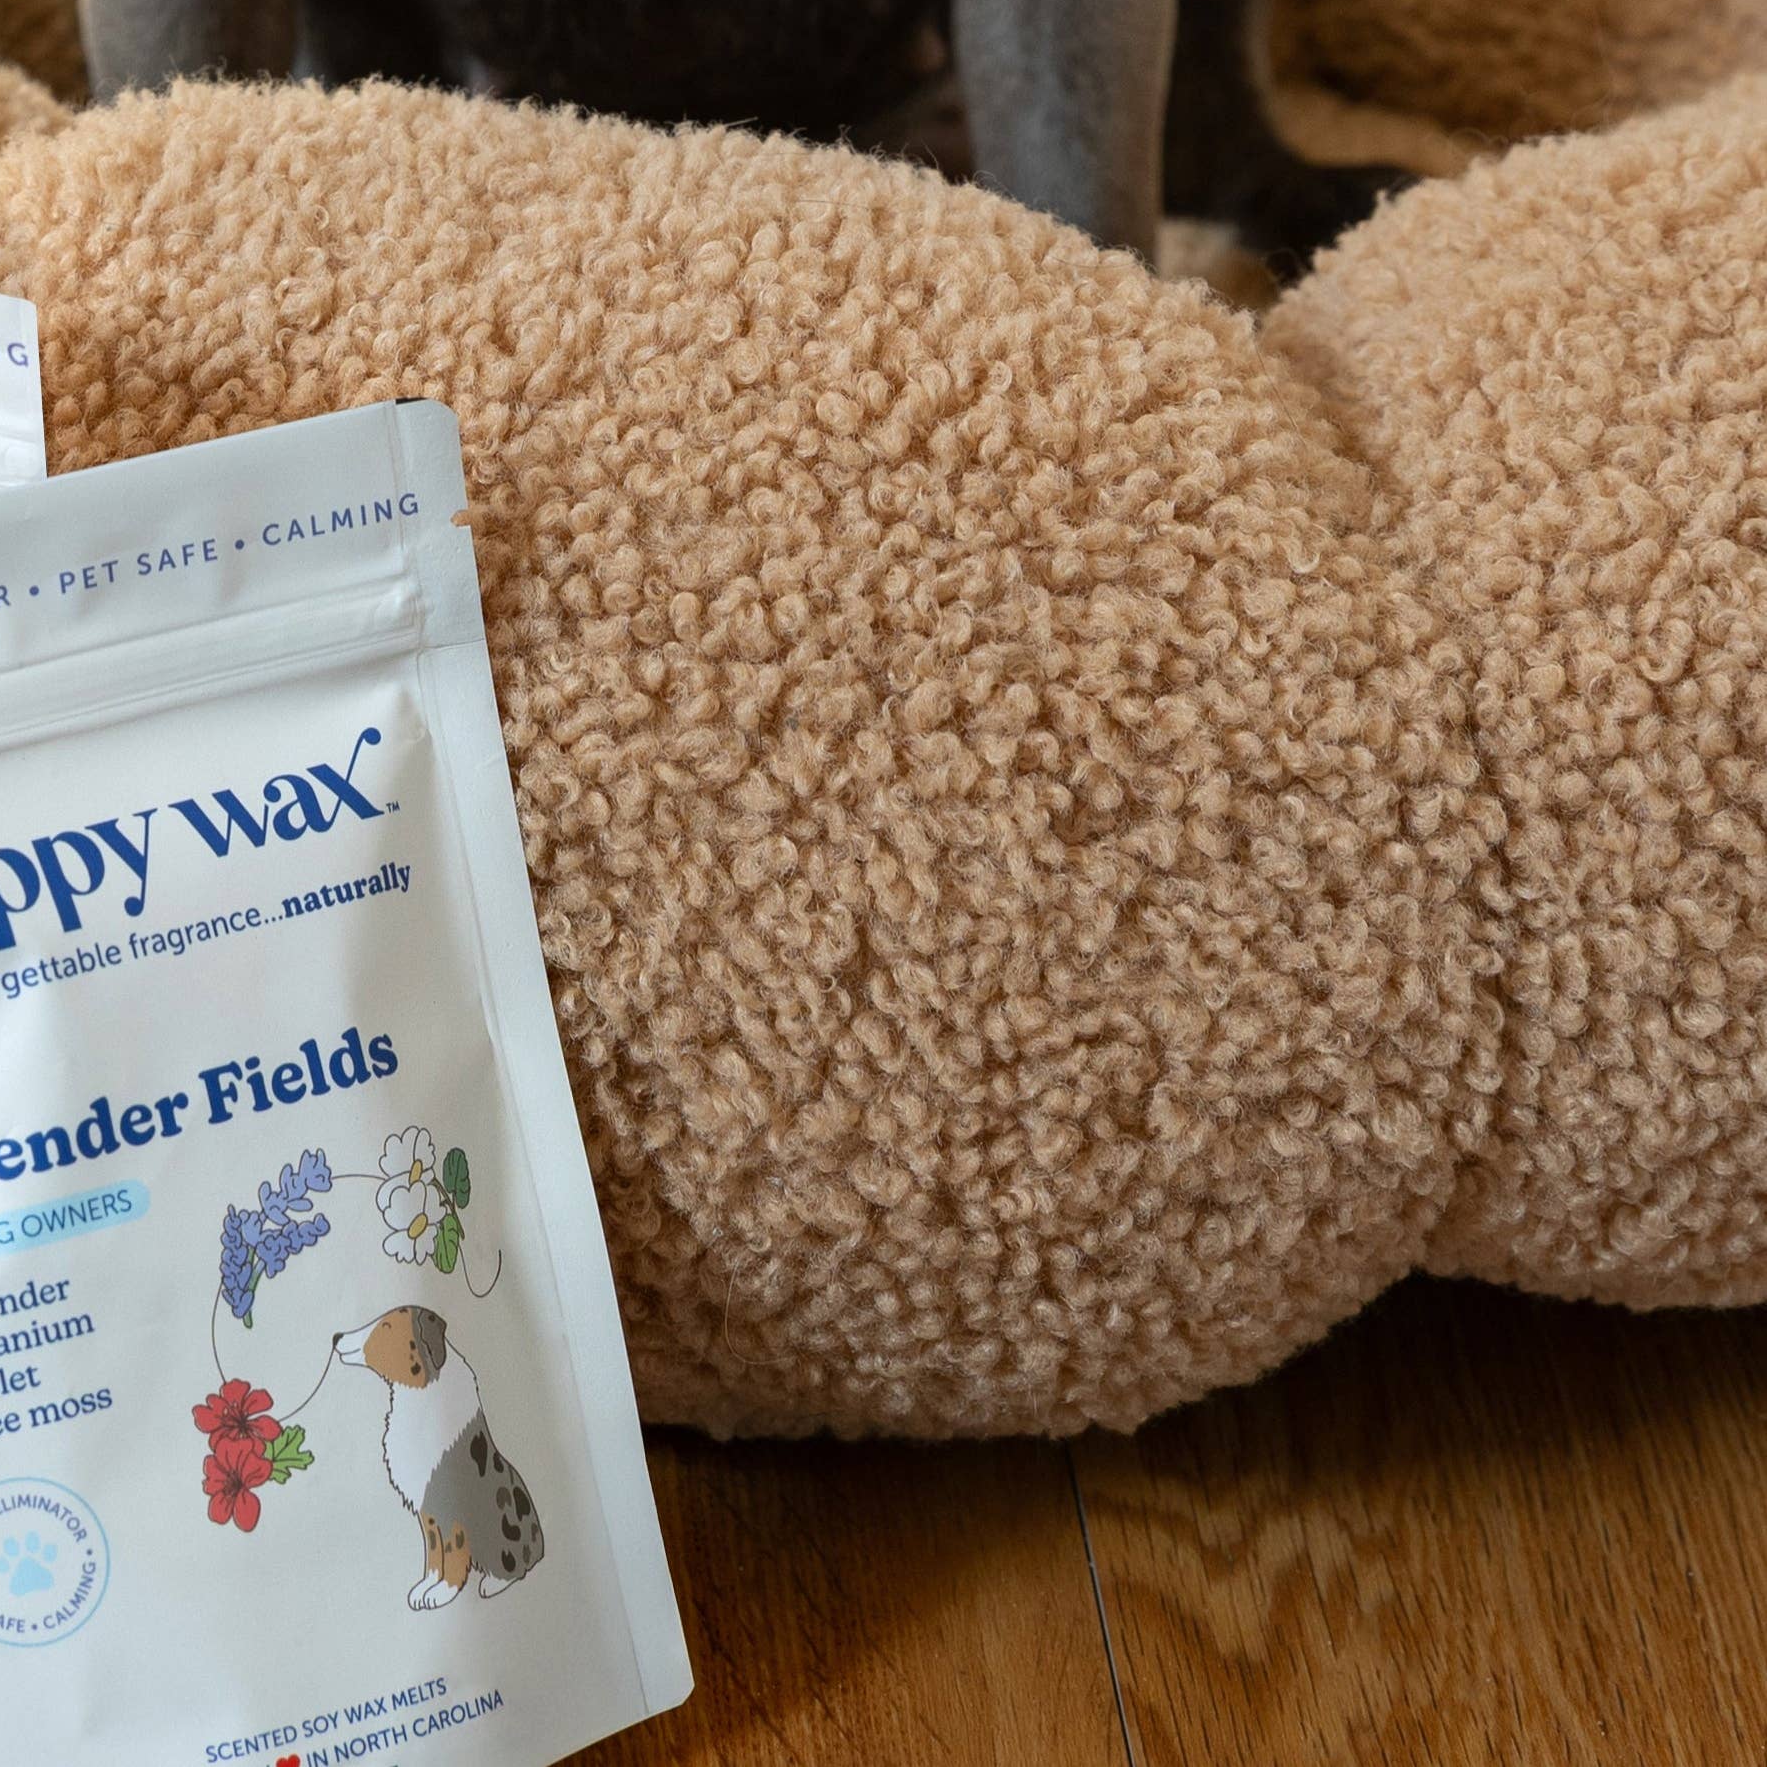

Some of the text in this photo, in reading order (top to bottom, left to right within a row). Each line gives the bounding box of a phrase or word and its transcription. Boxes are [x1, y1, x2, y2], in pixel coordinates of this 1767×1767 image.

[59, 560, 119, 594] PET
[136, 539, 218, 576] SAFE
[262, 493, 420, 546] CALMING
[168, 727, 385, 858] wax
[198, 1027, 399, 1124] Fields
[20, 1189, 133, 1239] OWNERS
[28, 1388, 113, 1428] moss
[43, 1561, 96, 1630] CALMING
[205, 1677, 447, 1764] SCENTED SOY WAX MELTS
[306, 1689, 504, 1767] IN NORTH CAROLINA
